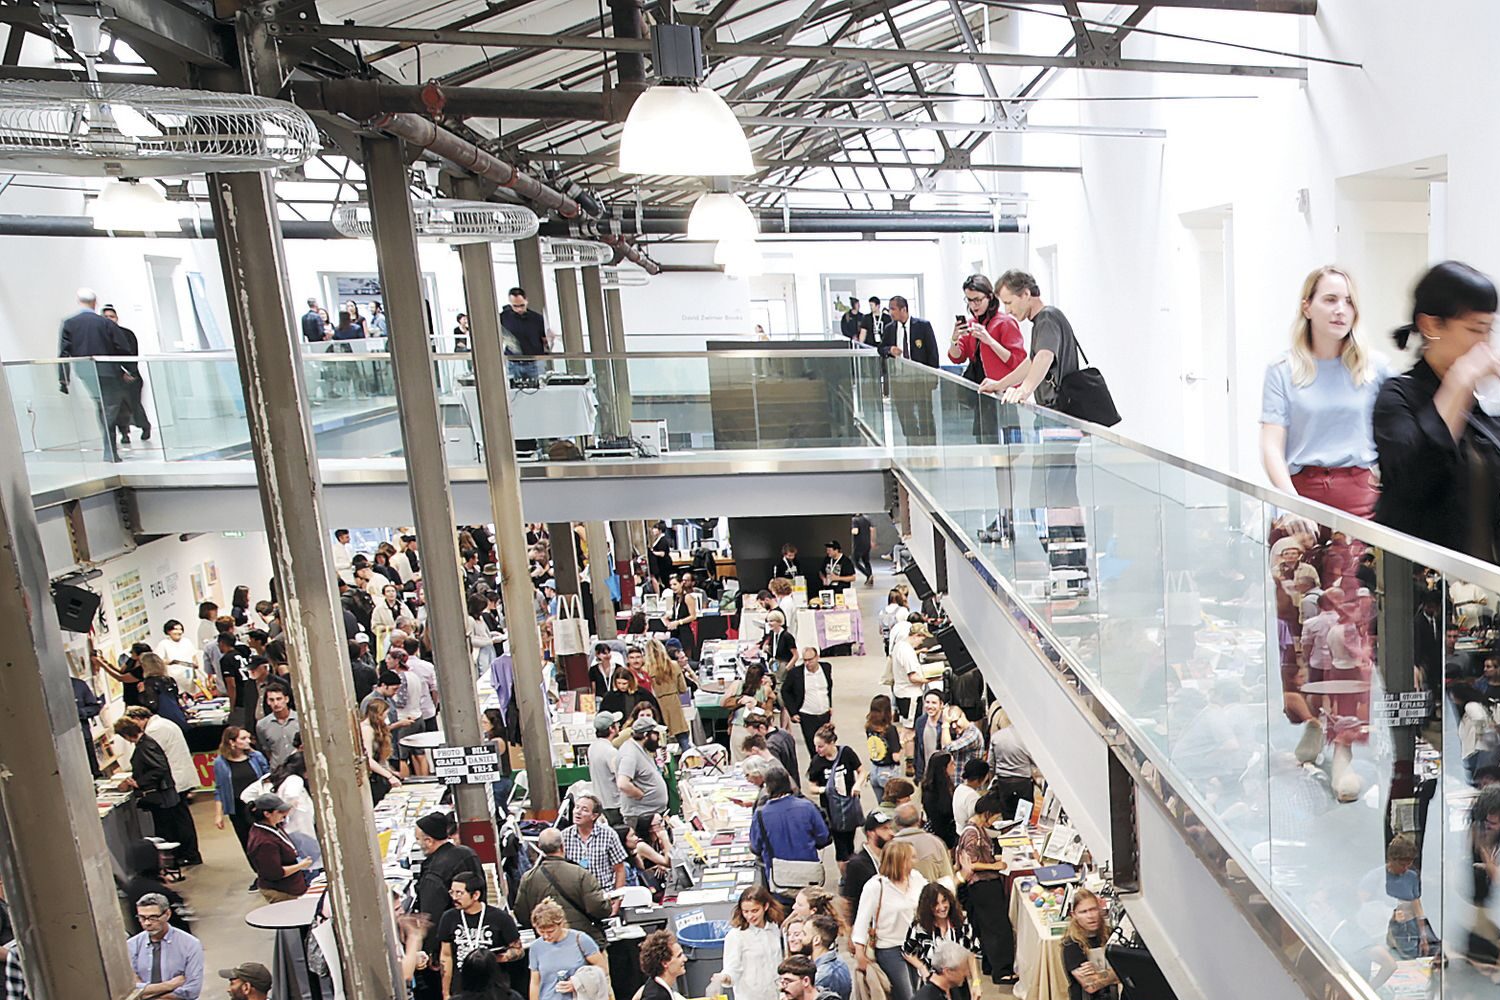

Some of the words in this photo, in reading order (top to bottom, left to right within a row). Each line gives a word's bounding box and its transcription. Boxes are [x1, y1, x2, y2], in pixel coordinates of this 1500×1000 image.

[437, 749, 461, 757] PHOTO
[471, 746, 490, 755] BILL
[436, 758, 464, 766] GRAPHS
[468, 755, 495, 763] DANIEL
[472, 764, 493, 773] TRI-X
